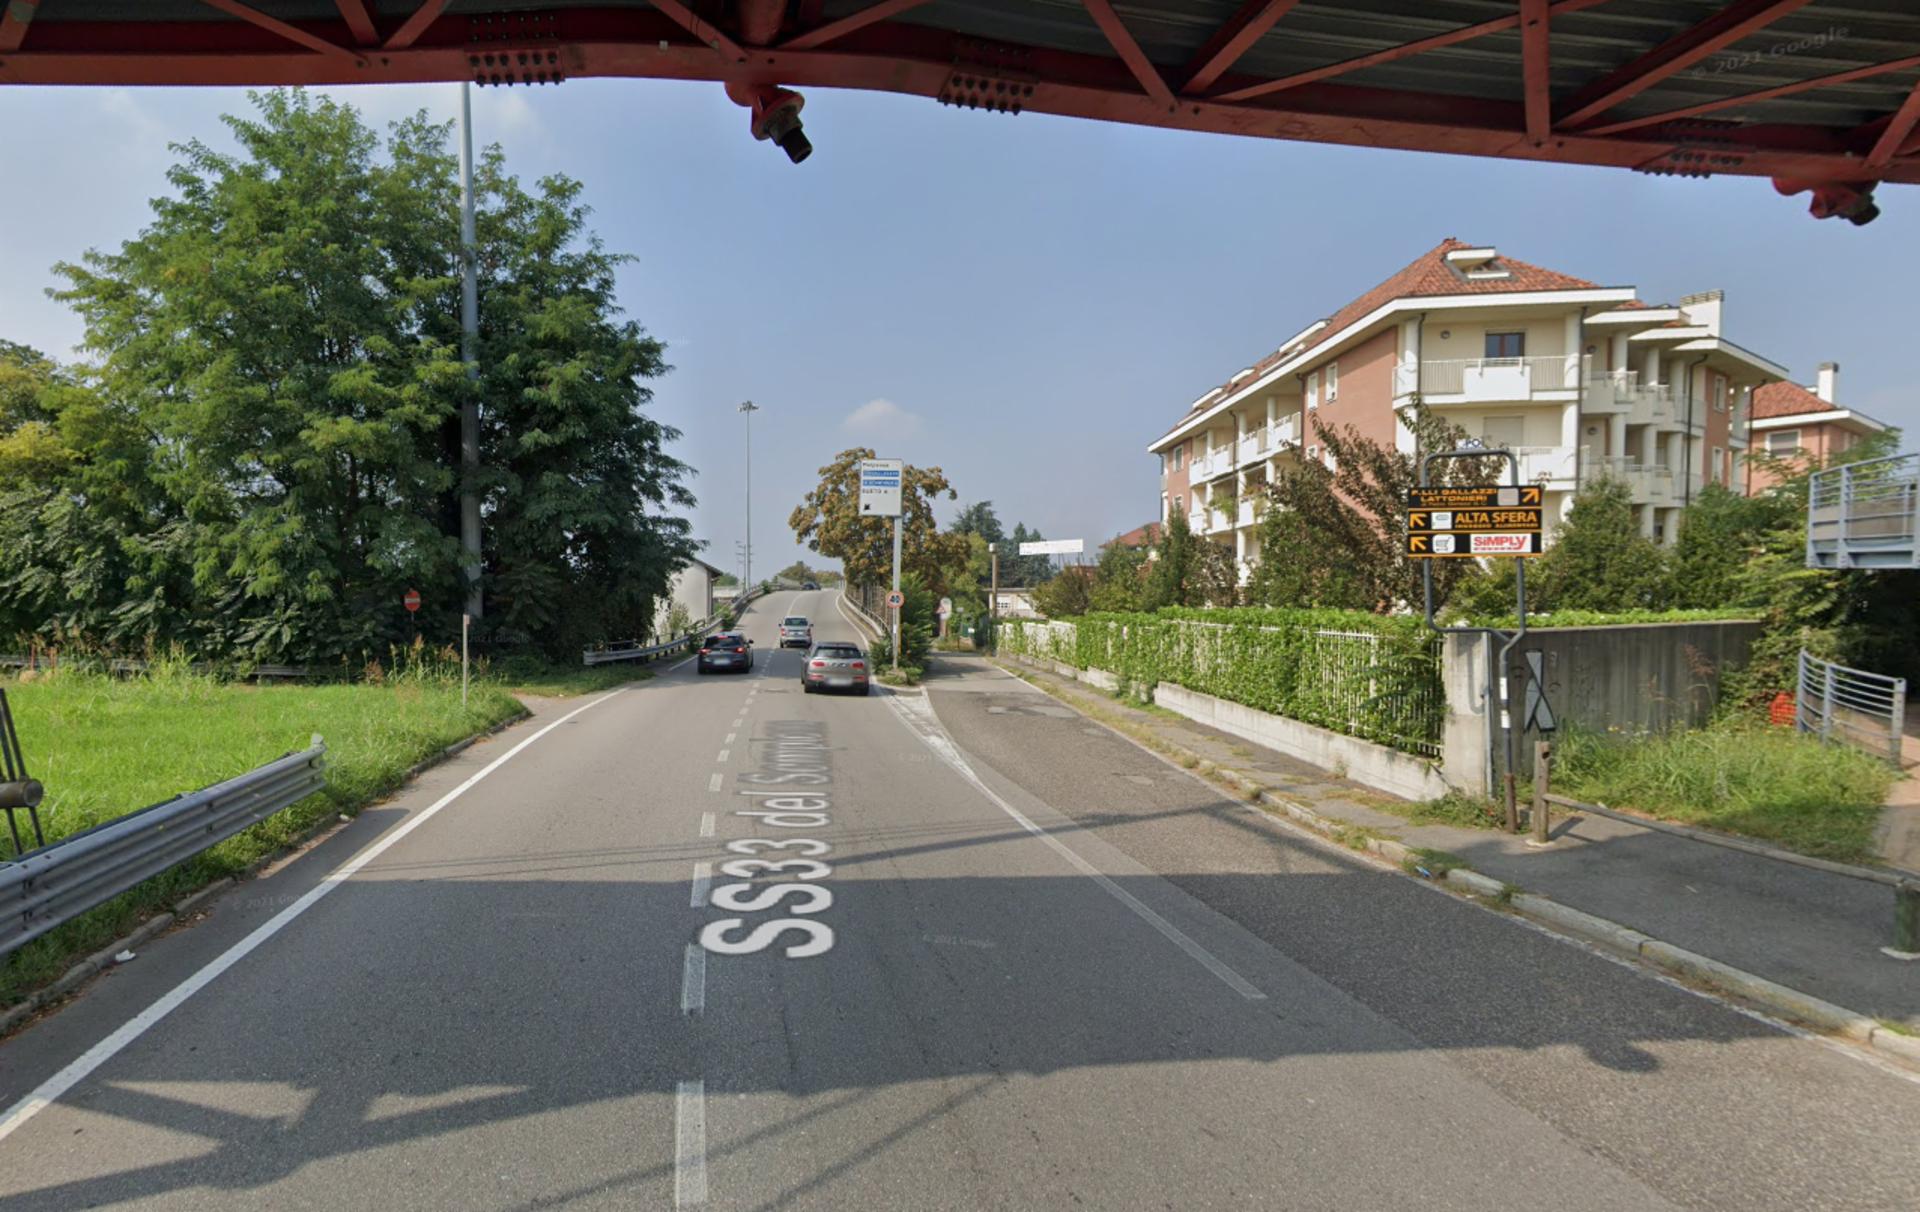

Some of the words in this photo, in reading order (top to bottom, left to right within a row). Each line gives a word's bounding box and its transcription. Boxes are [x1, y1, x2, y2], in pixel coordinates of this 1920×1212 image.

[1420, 495, 1488, 503] LATTONIERI
[1455, 512, 1490, 524] ALTA
[1492, 511, 1538, 523] SFERA
